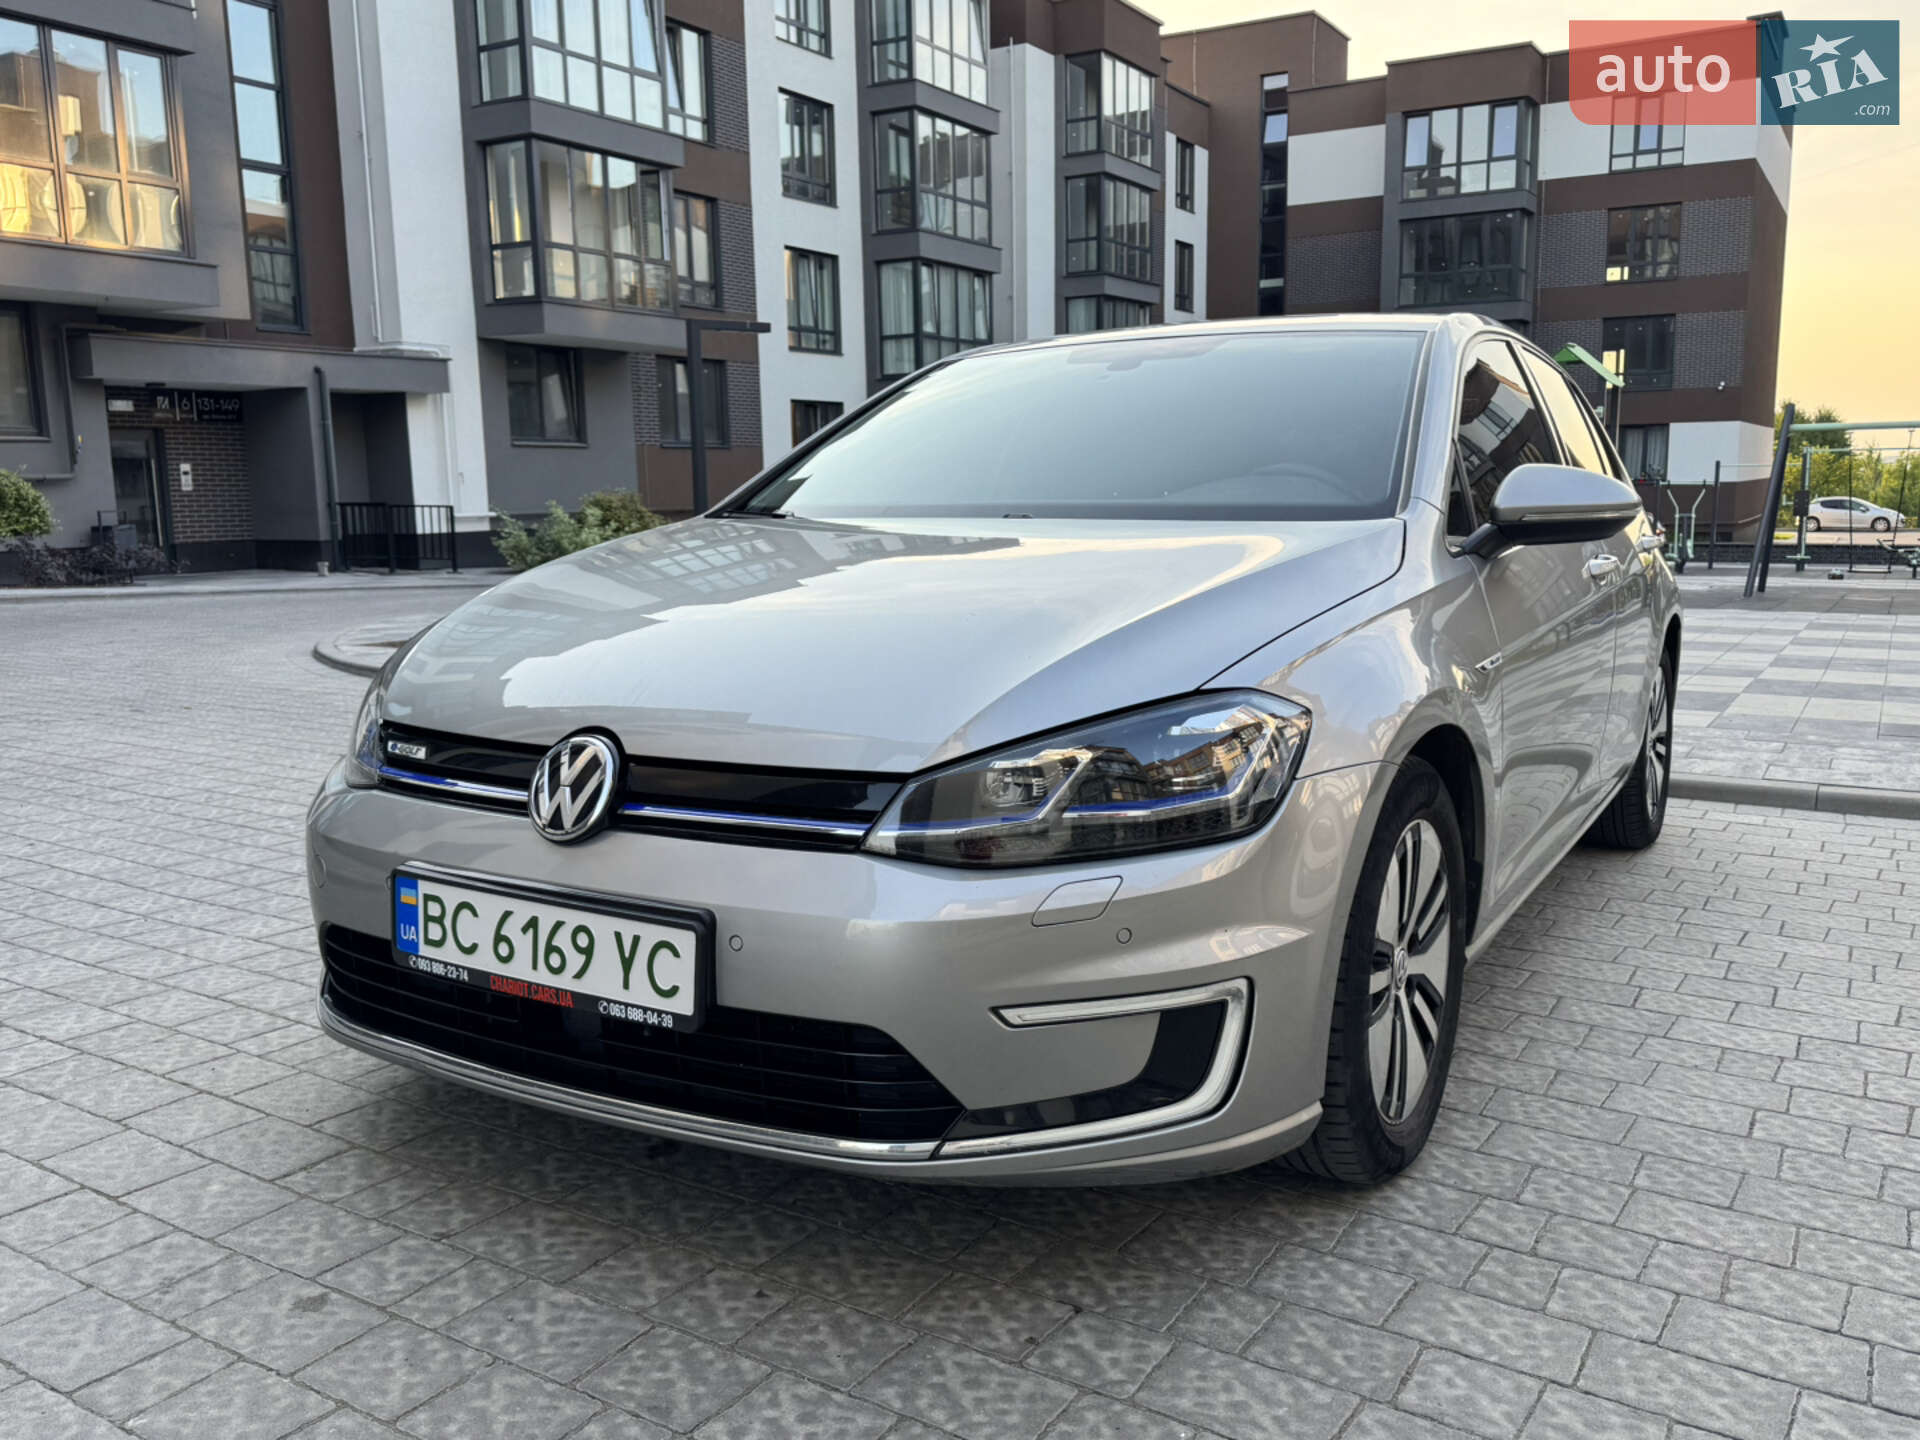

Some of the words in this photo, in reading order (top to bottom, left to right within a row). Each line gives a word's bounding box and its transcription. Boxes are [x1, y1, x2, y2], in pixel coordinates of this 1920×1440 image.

[400, 924, 418, 942] UA
[422, 893, 479, 955] BC
[492, 910, 595, 980] 6169
[613, 930, 681, 998] YC
[609, 1002, 625, 1018] 063
[627, 1005, 673, 1028] 688-04-39
